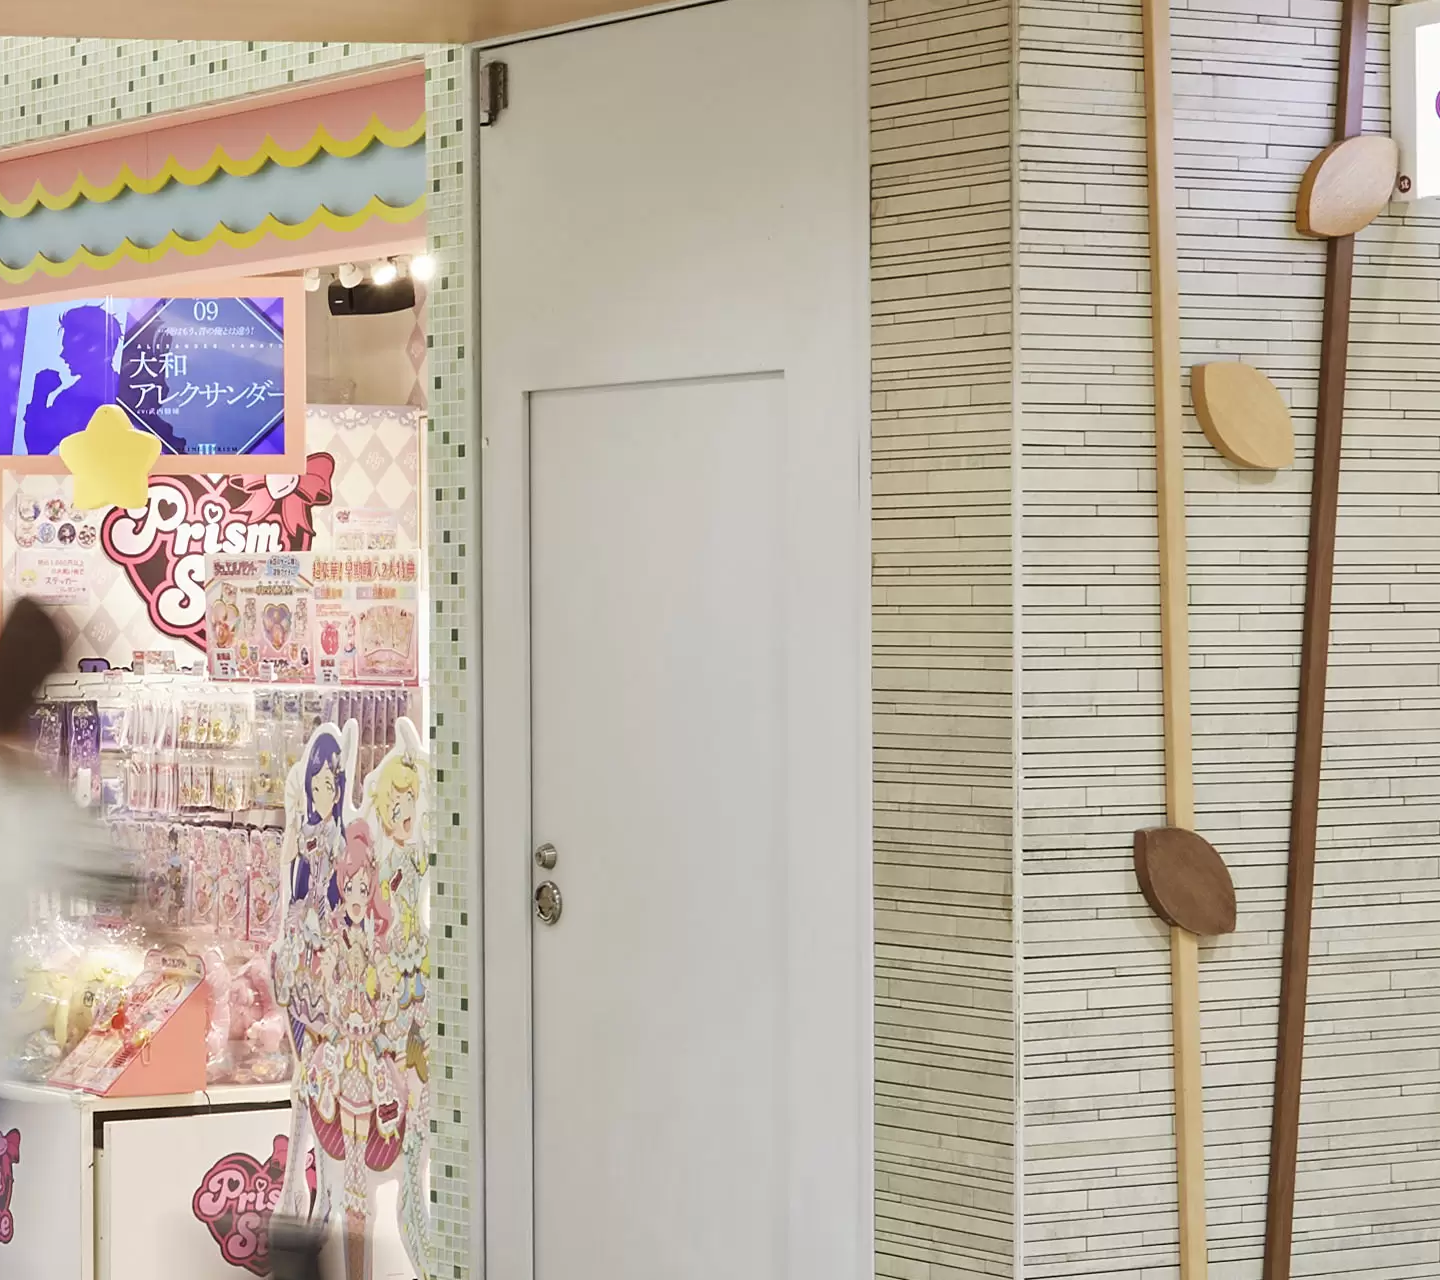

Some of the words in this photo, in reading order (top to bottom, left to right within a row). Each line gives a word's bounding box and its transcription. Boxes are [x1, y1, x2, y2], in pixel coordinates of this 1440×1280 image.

[193, 301, 219, 322] 09
[129, 351, 188, 379] 大和
[129, 379, 285, 409] アレクサンダー
[110, 484, 283, 556] Prism
[199, 1168, 281, 1216] Pris
